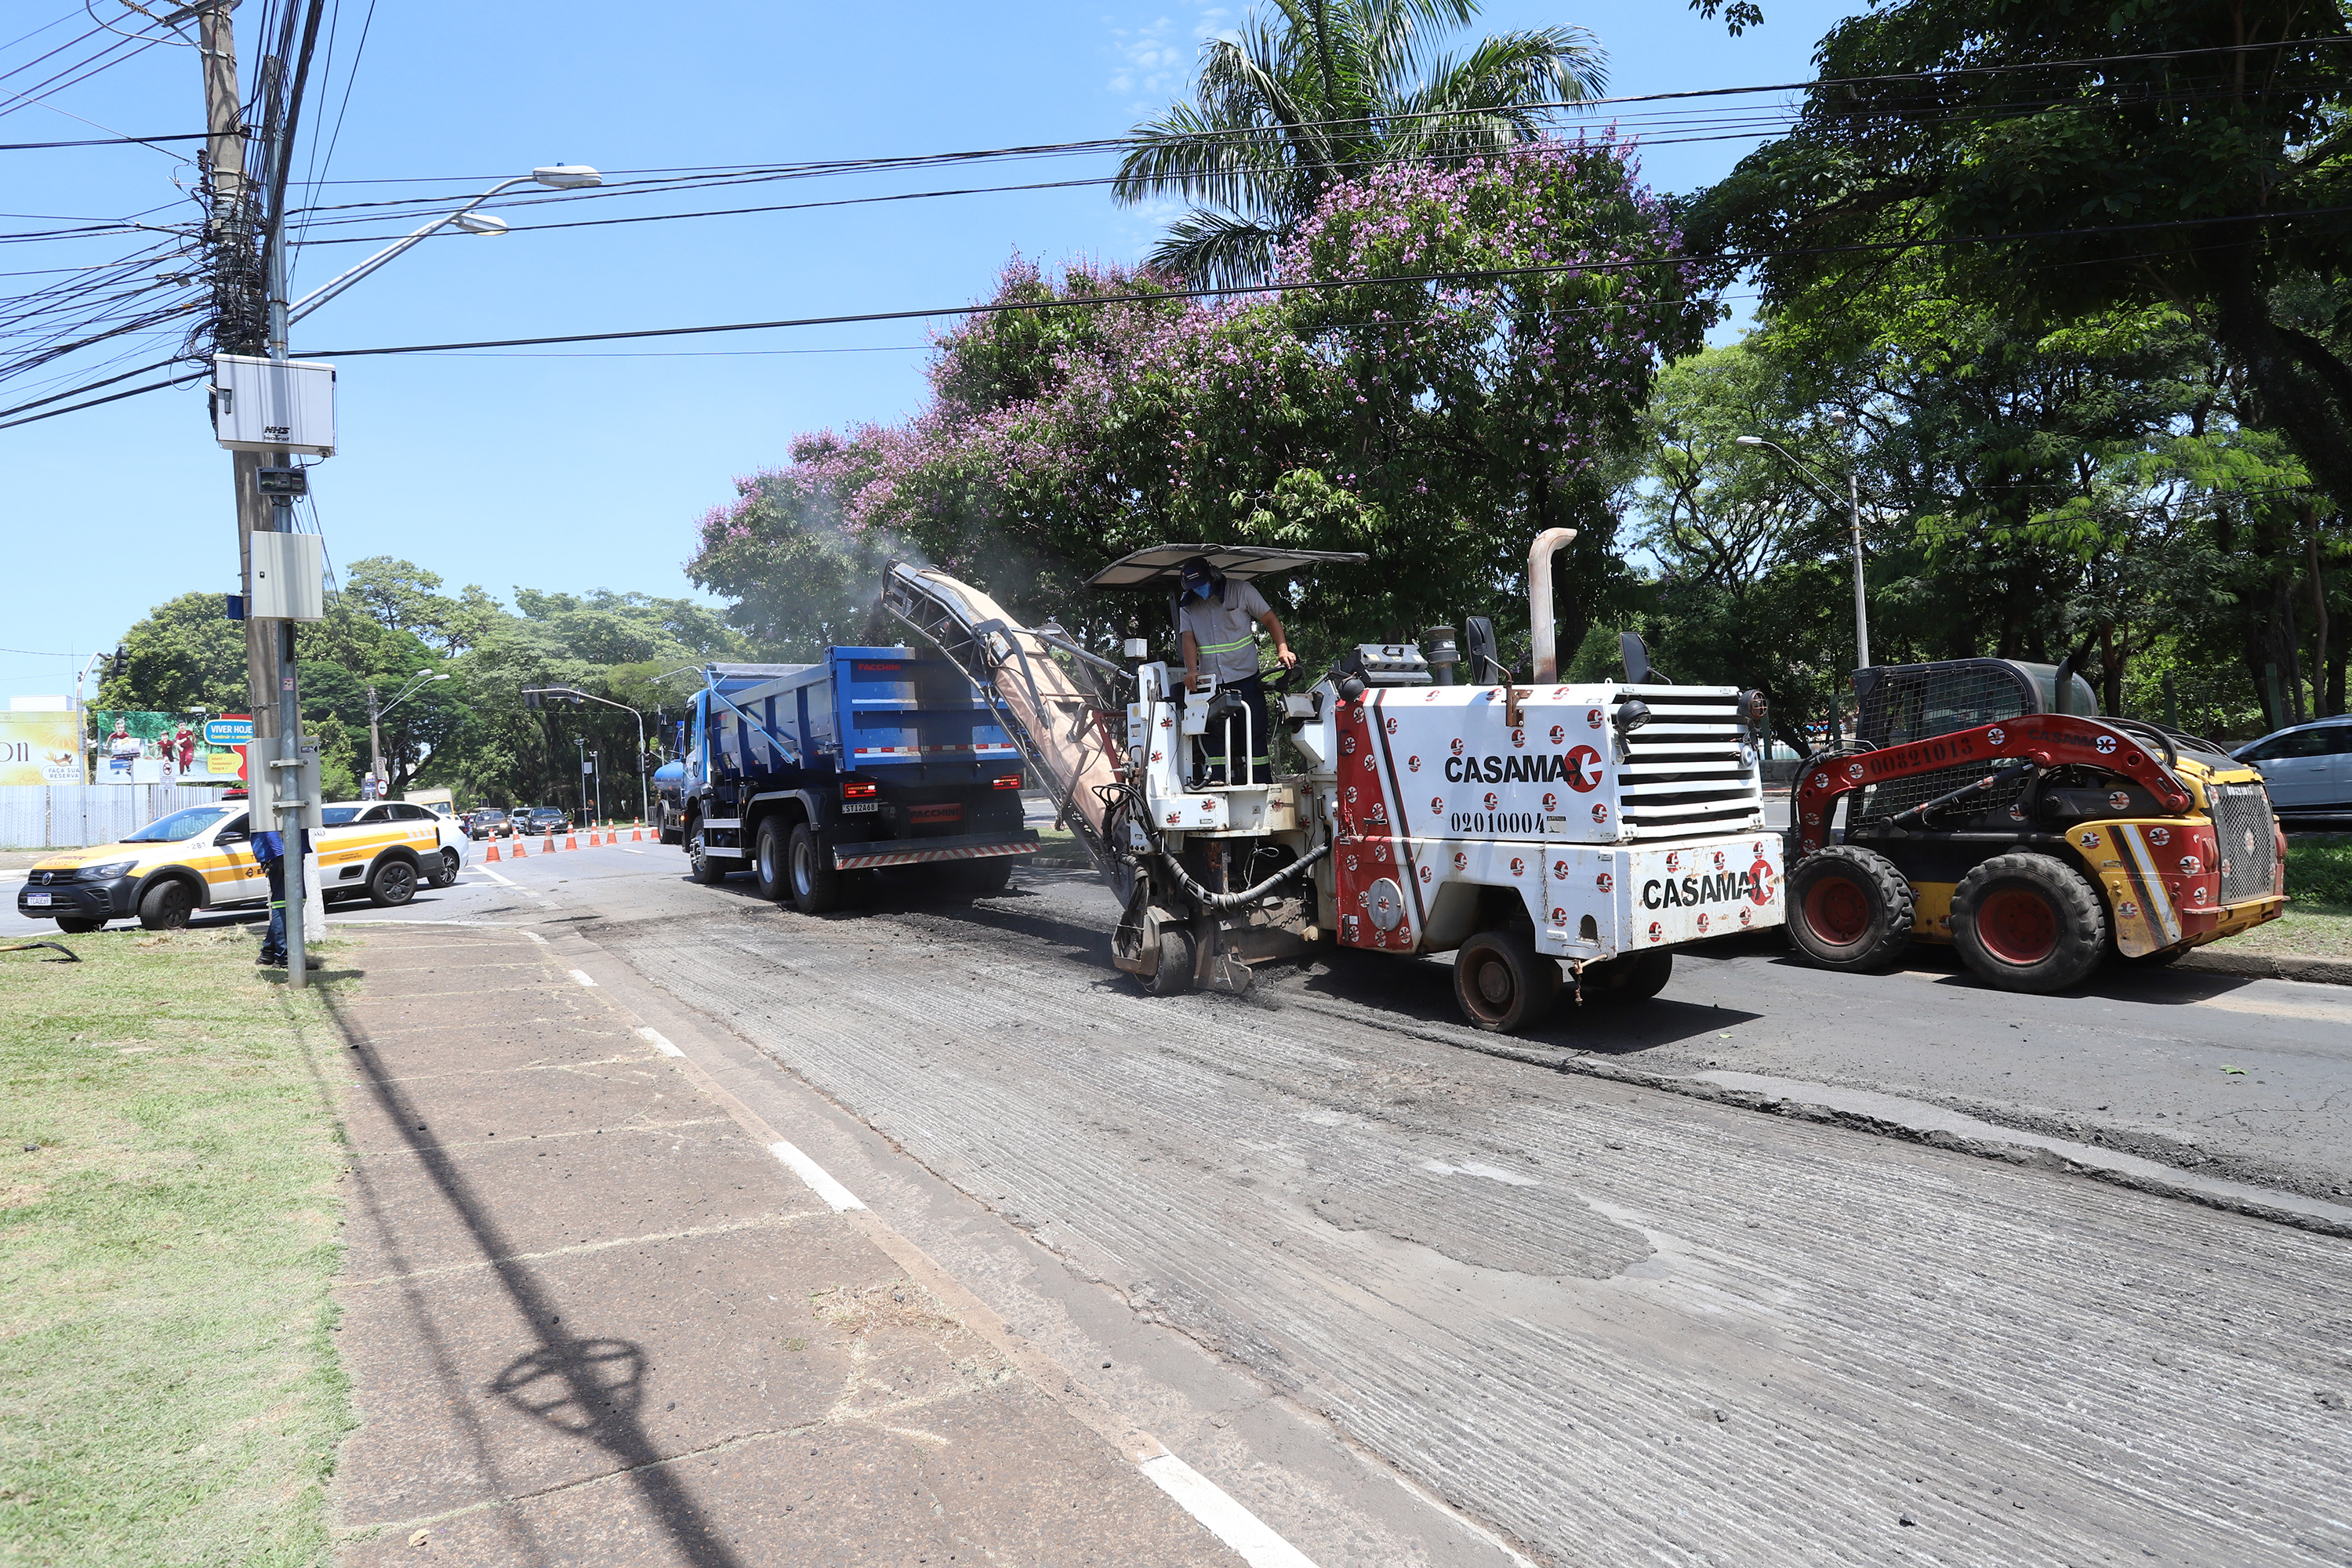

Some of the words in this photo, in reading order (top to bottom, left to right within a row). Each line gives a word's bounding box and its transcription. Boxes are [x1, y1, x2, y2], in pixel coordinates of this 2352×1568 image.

[263, 426, 290, 434] NHS
[211, 725, 232, 734] VIVER
[1870, 737, 1974, 775] 00821013
[1445, 753, 1603, 785] CASAMAX
[846, 804, 875, 812] STI2A68
[909, 808, 960, 818] FACCHINI
[191, 841, 206, 850] 281
[1643, 866, 1774, 909] CASAMAX
